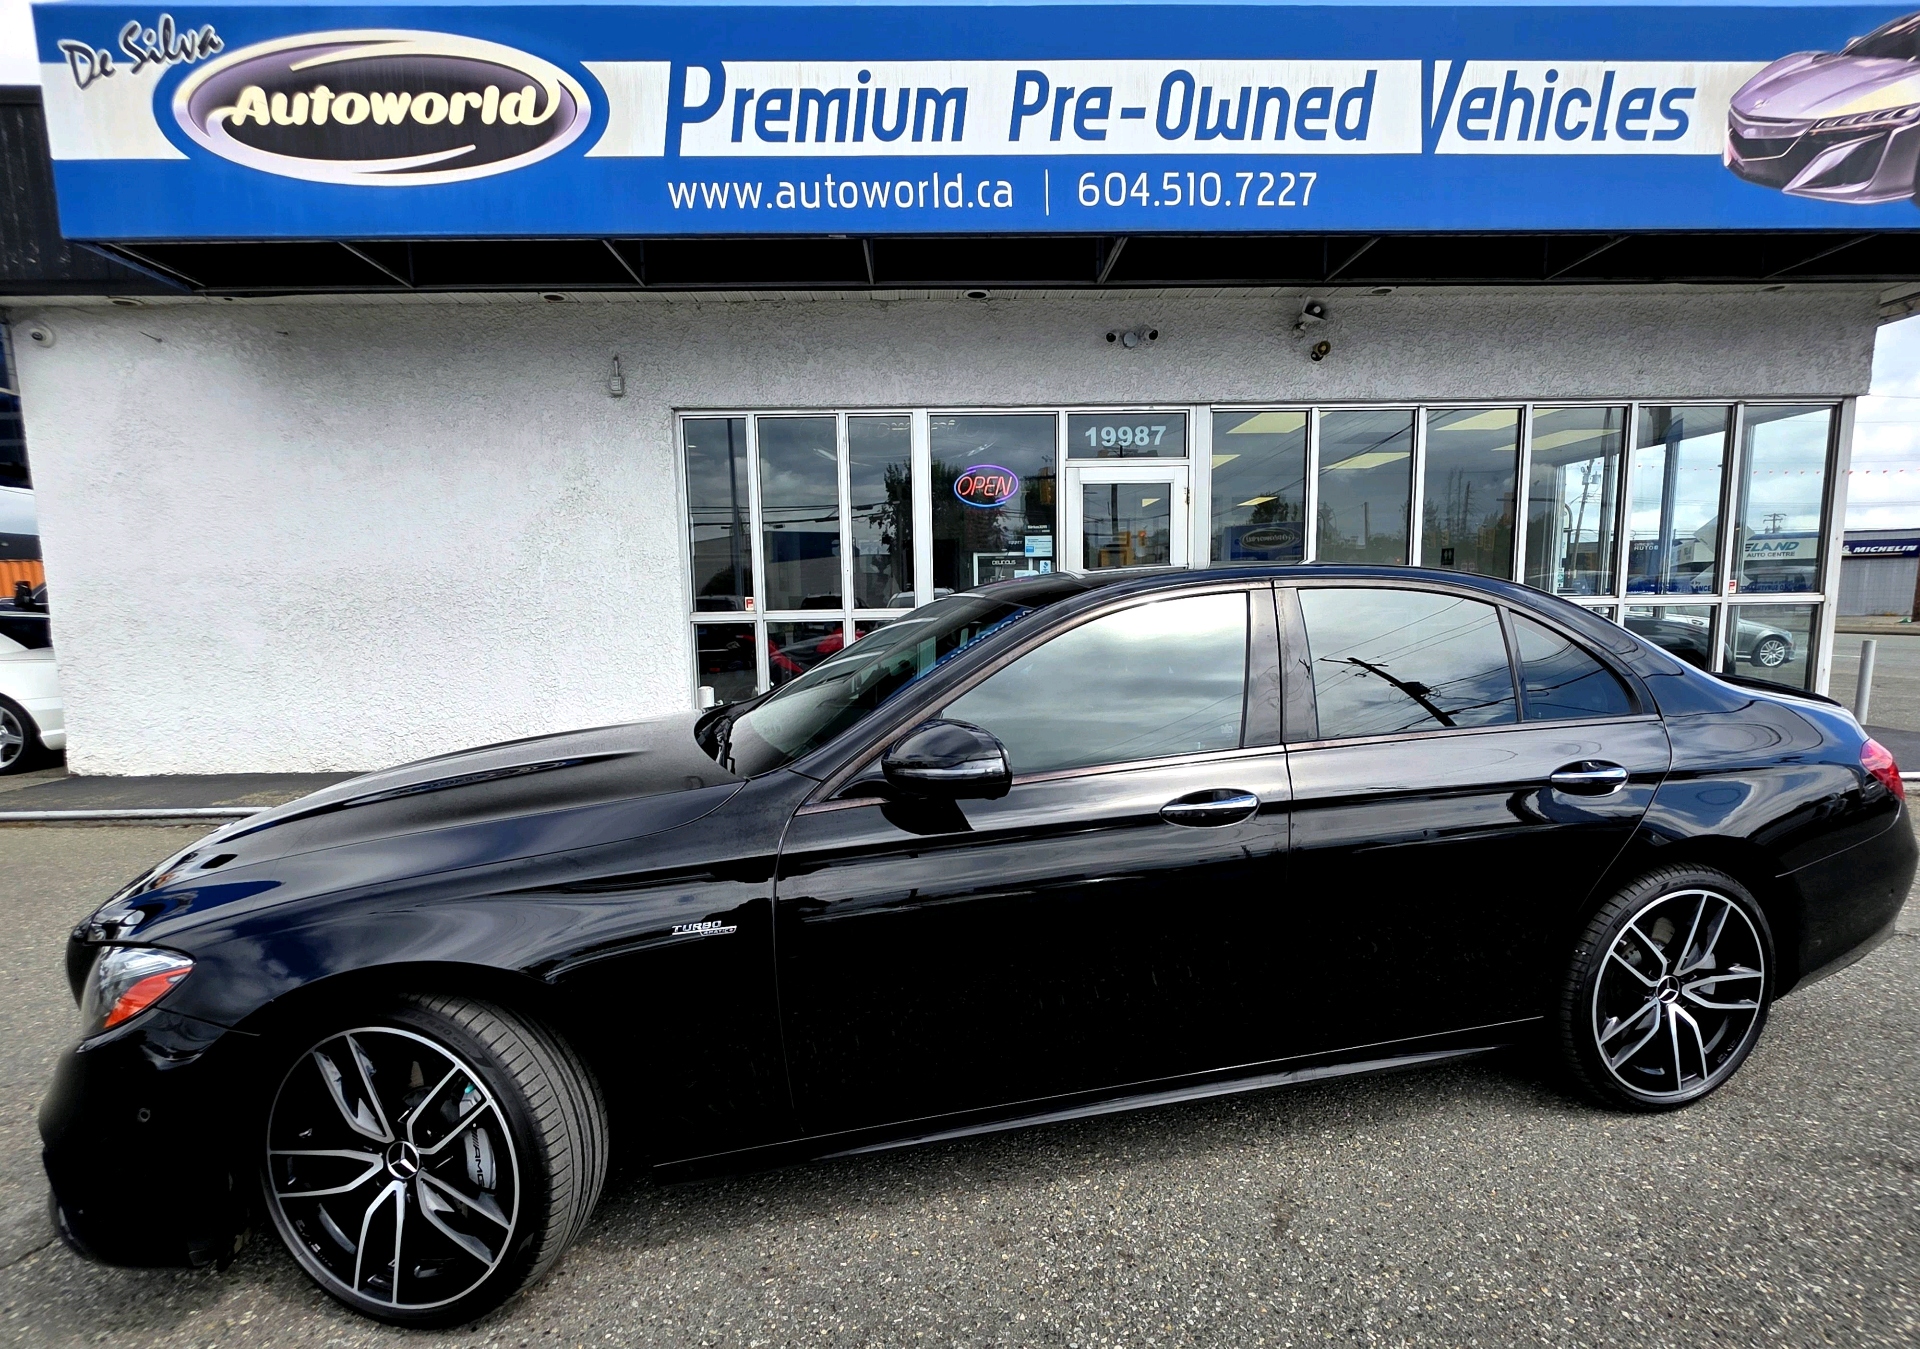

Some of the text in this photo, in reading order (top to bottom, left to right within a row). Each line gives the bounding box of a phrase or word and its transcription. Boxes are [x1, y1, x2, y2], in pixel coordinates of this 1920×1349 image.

[57, 13, 225, 91] De Silva
[231, 85, 550, 126] Autoworld
[663, 60, 1695, 157] Premium Pre-Owned Vehicles
[668, 172, 1318, 210] www.autoworld.ca 604.510.7227
[1085, 425, 1167, 447] 19987
[957, 475, 1013, 496] OPEN
[1853, 544, 1918, 553] MICHELIN
[672, 920, 722, 933] TURBO
[473, 1144, 485, 1187] AMG
